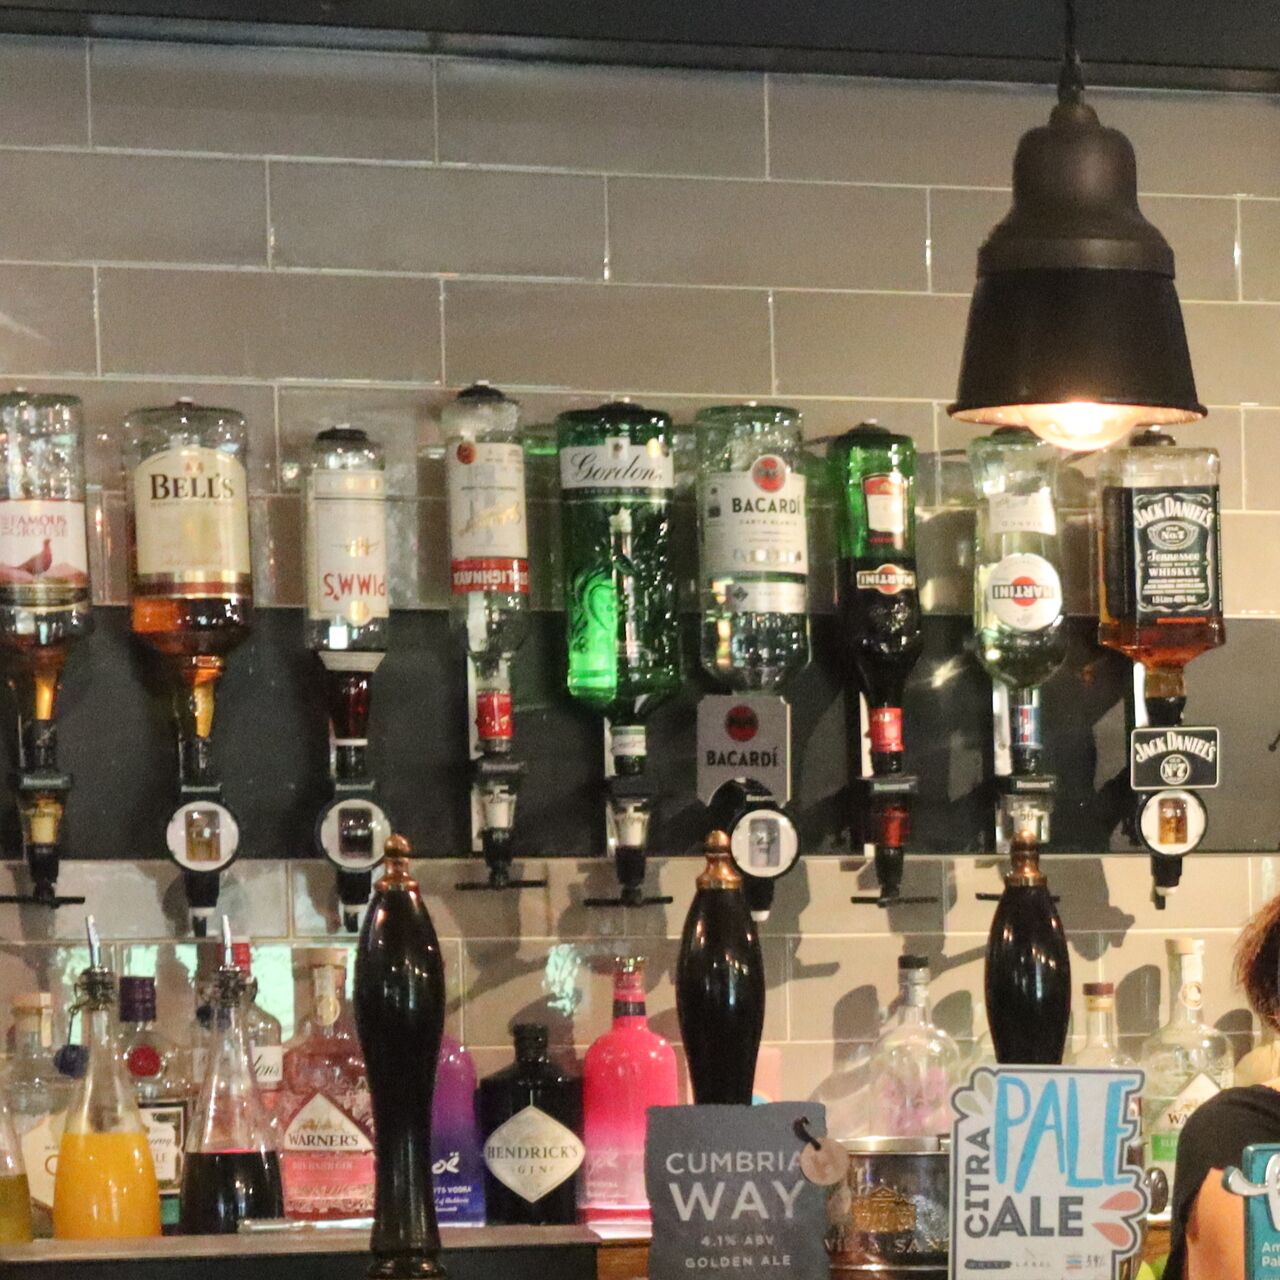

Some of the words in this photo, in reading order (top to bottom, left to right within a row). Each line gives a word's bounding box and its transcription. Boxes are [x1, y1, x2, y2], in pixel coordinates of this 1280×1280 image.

[149, 471, 236, 500] BELL'S
[1133, 503, 1165, 528] JACK
[1164, 497, 1215, 529] DANIEL'S
[1147, 550, 1200, 562] Tennessee
[861, 574, 914, 587] MARTINI
[1148, 567, 1200, 577] WHISKEY
[1135, 736, 1167, 762] JACK
[1166, 731, 1216, 762] DANIEL'S
[706, 747, 779, 769] BACARDÍ
[289, 1132, 359, 1147] WARNER'S
[995, 1076, 1137, 1193] PALE
[486, 1146, 578, 1160] HENDRICK'S
[517, 1165, 547, 1174] GIN
[964, 1127, 990, 1239] CITRA
[668, 1181, 804, 1222] WAY
[989, 1196, 1084, 1237] ALE
[700, 1235, 737, 1247] 4.1%
[743, 1235, 775, 1246] ABV
[685, 1257, 753, 1269] GOLDEN
[761, 1255, 792, 1266] ALE
